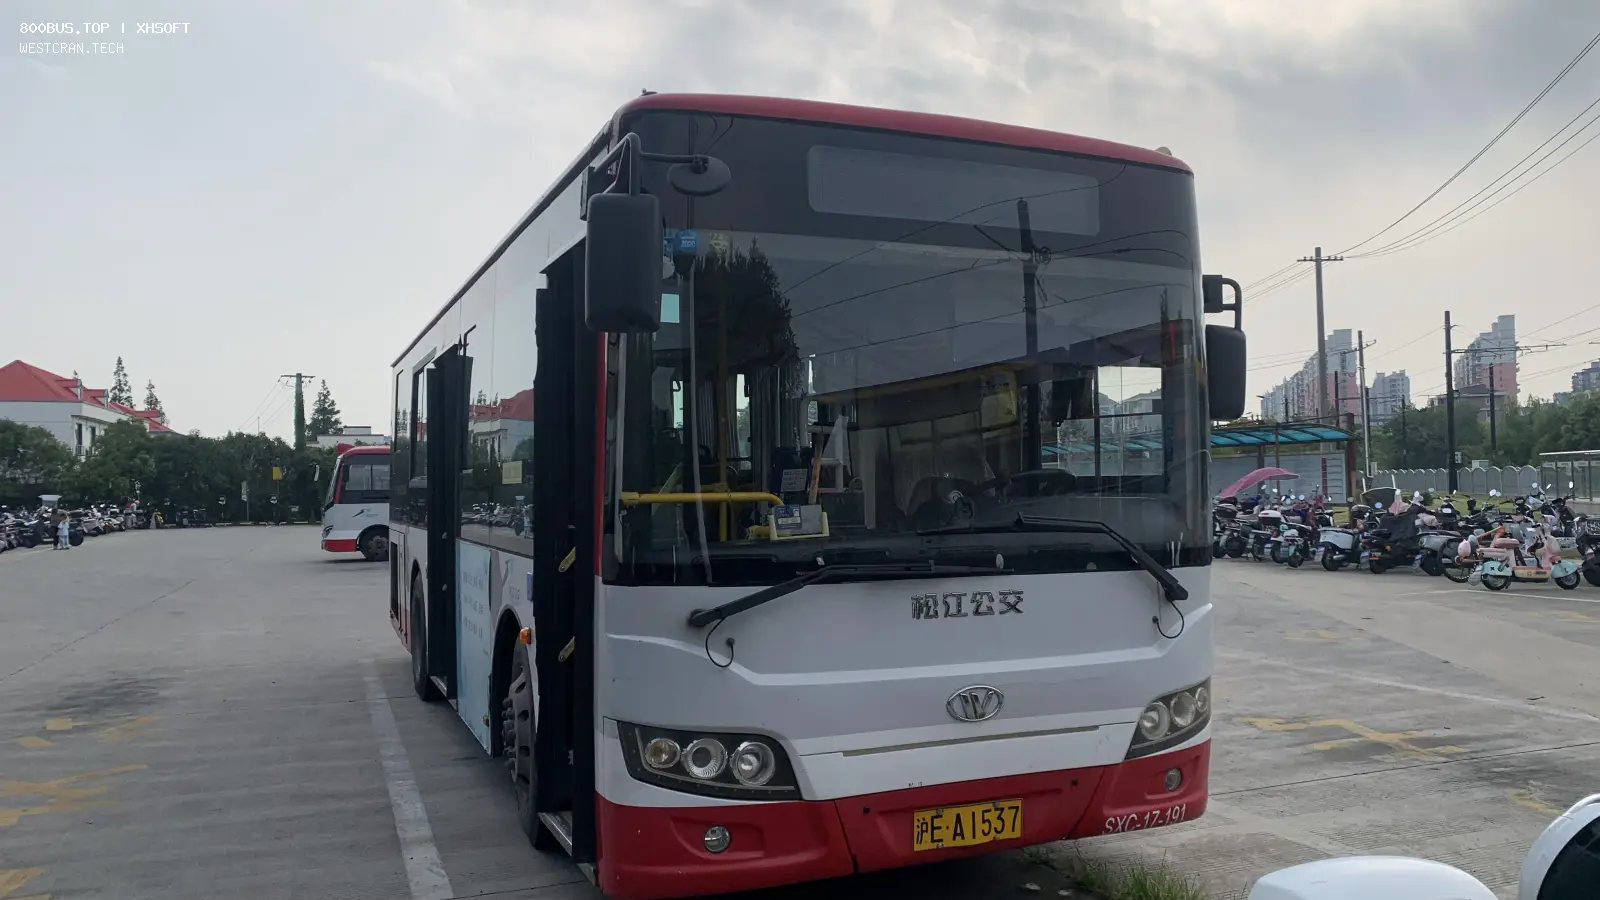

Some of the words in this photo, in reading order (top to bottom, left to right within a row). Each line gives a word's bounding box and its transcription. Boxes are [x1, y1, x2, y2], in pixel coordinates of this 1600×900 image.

[910, 588, 1024, 620] 松江公交
[1105, 803, 1186, 833] SXC-17-191
